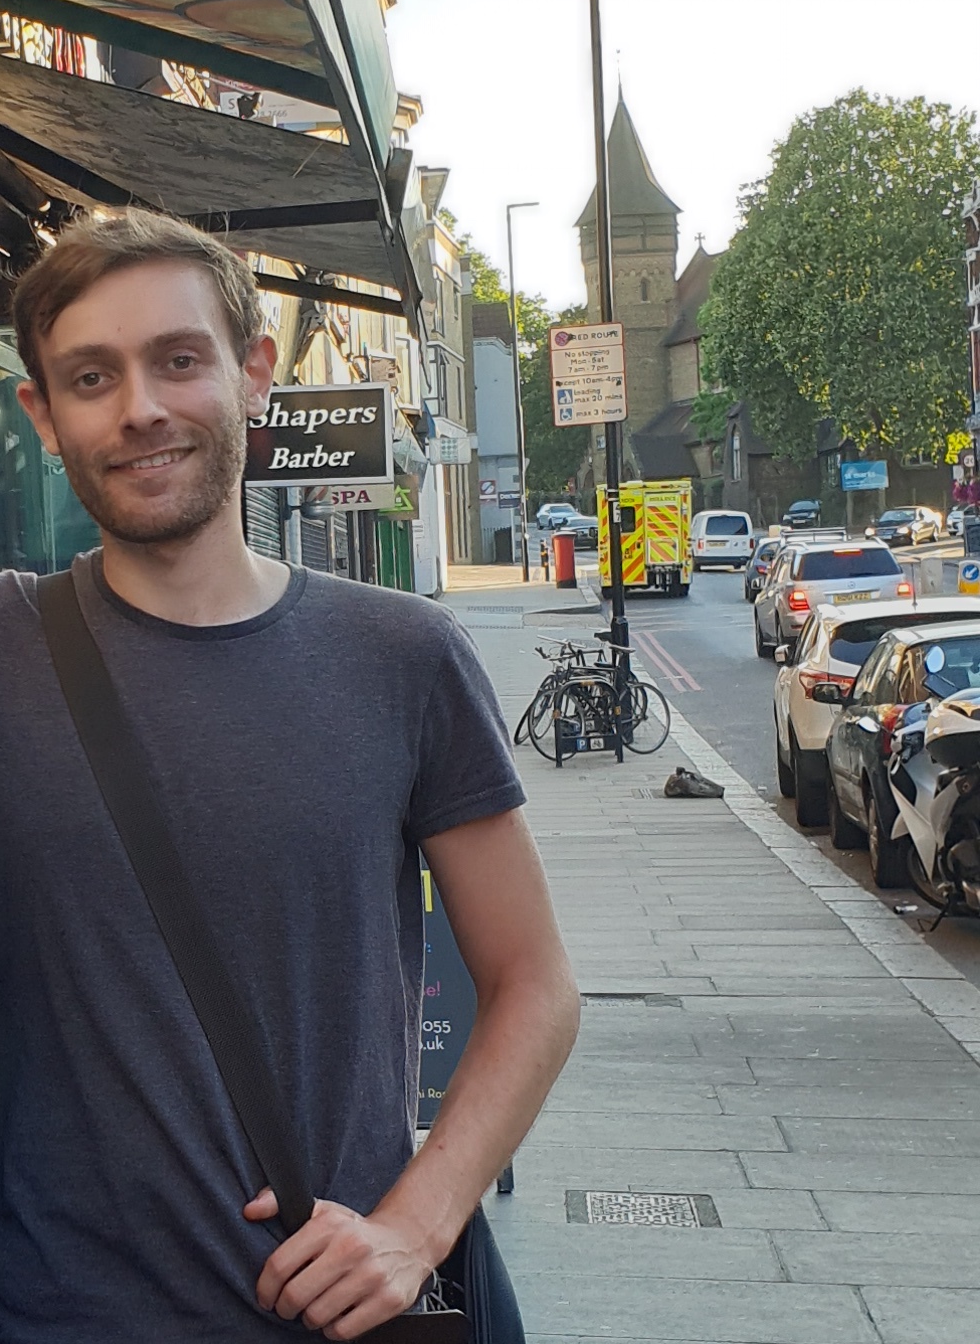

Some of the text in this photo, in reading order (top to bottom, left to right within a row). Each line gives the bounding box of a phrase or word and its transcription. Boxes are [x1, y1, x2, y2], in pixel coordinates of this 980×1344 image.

[591, 330, 618, 339] ROUTE
[577, 349, 610, 357] stopping
[268, 444, 356, 470] Barber
